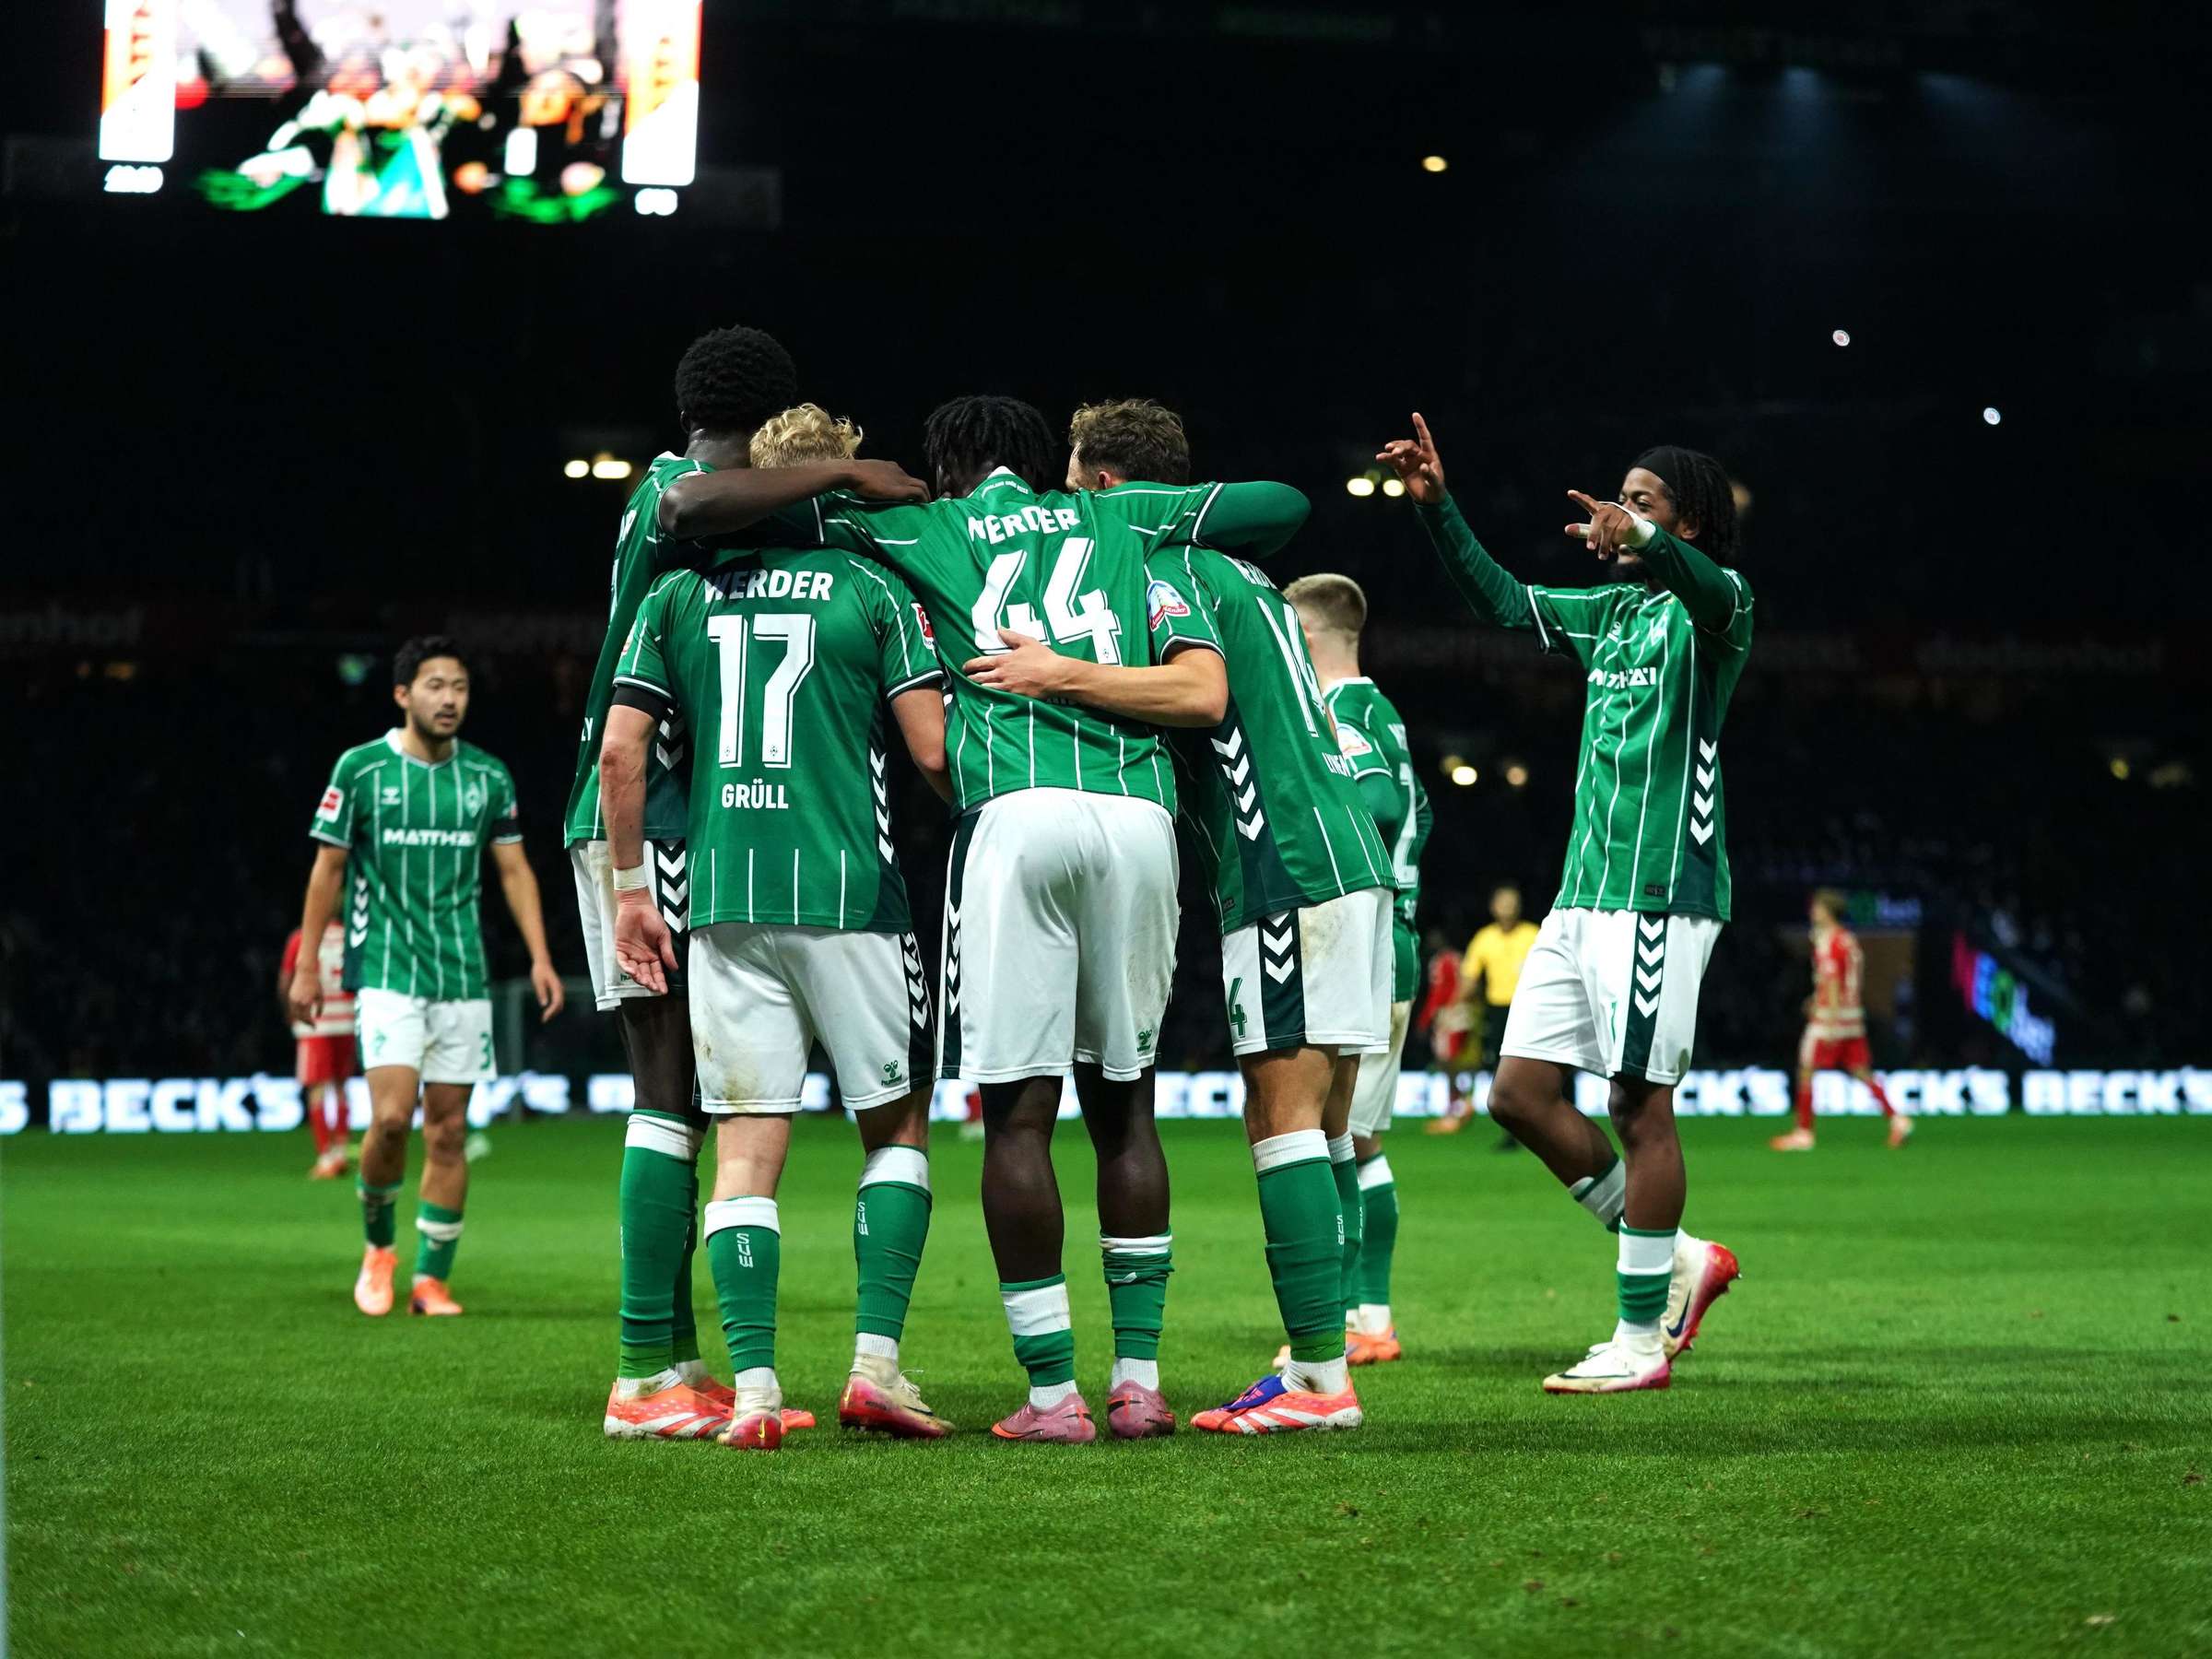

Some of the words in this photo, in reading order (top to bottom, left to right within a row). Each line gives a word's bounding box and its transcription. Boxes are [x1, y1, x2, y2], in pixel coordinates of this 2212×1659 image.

[968, 505, 1081, 545] WERDER
[704, 569, 834, 604] WERDER
[971, 537, 1123, 666] 44
[708, 613, 817, 769] 17
[722, 778, 789, 809] GRÜLL
[49, 1071, 304, 1135] BECK'S
